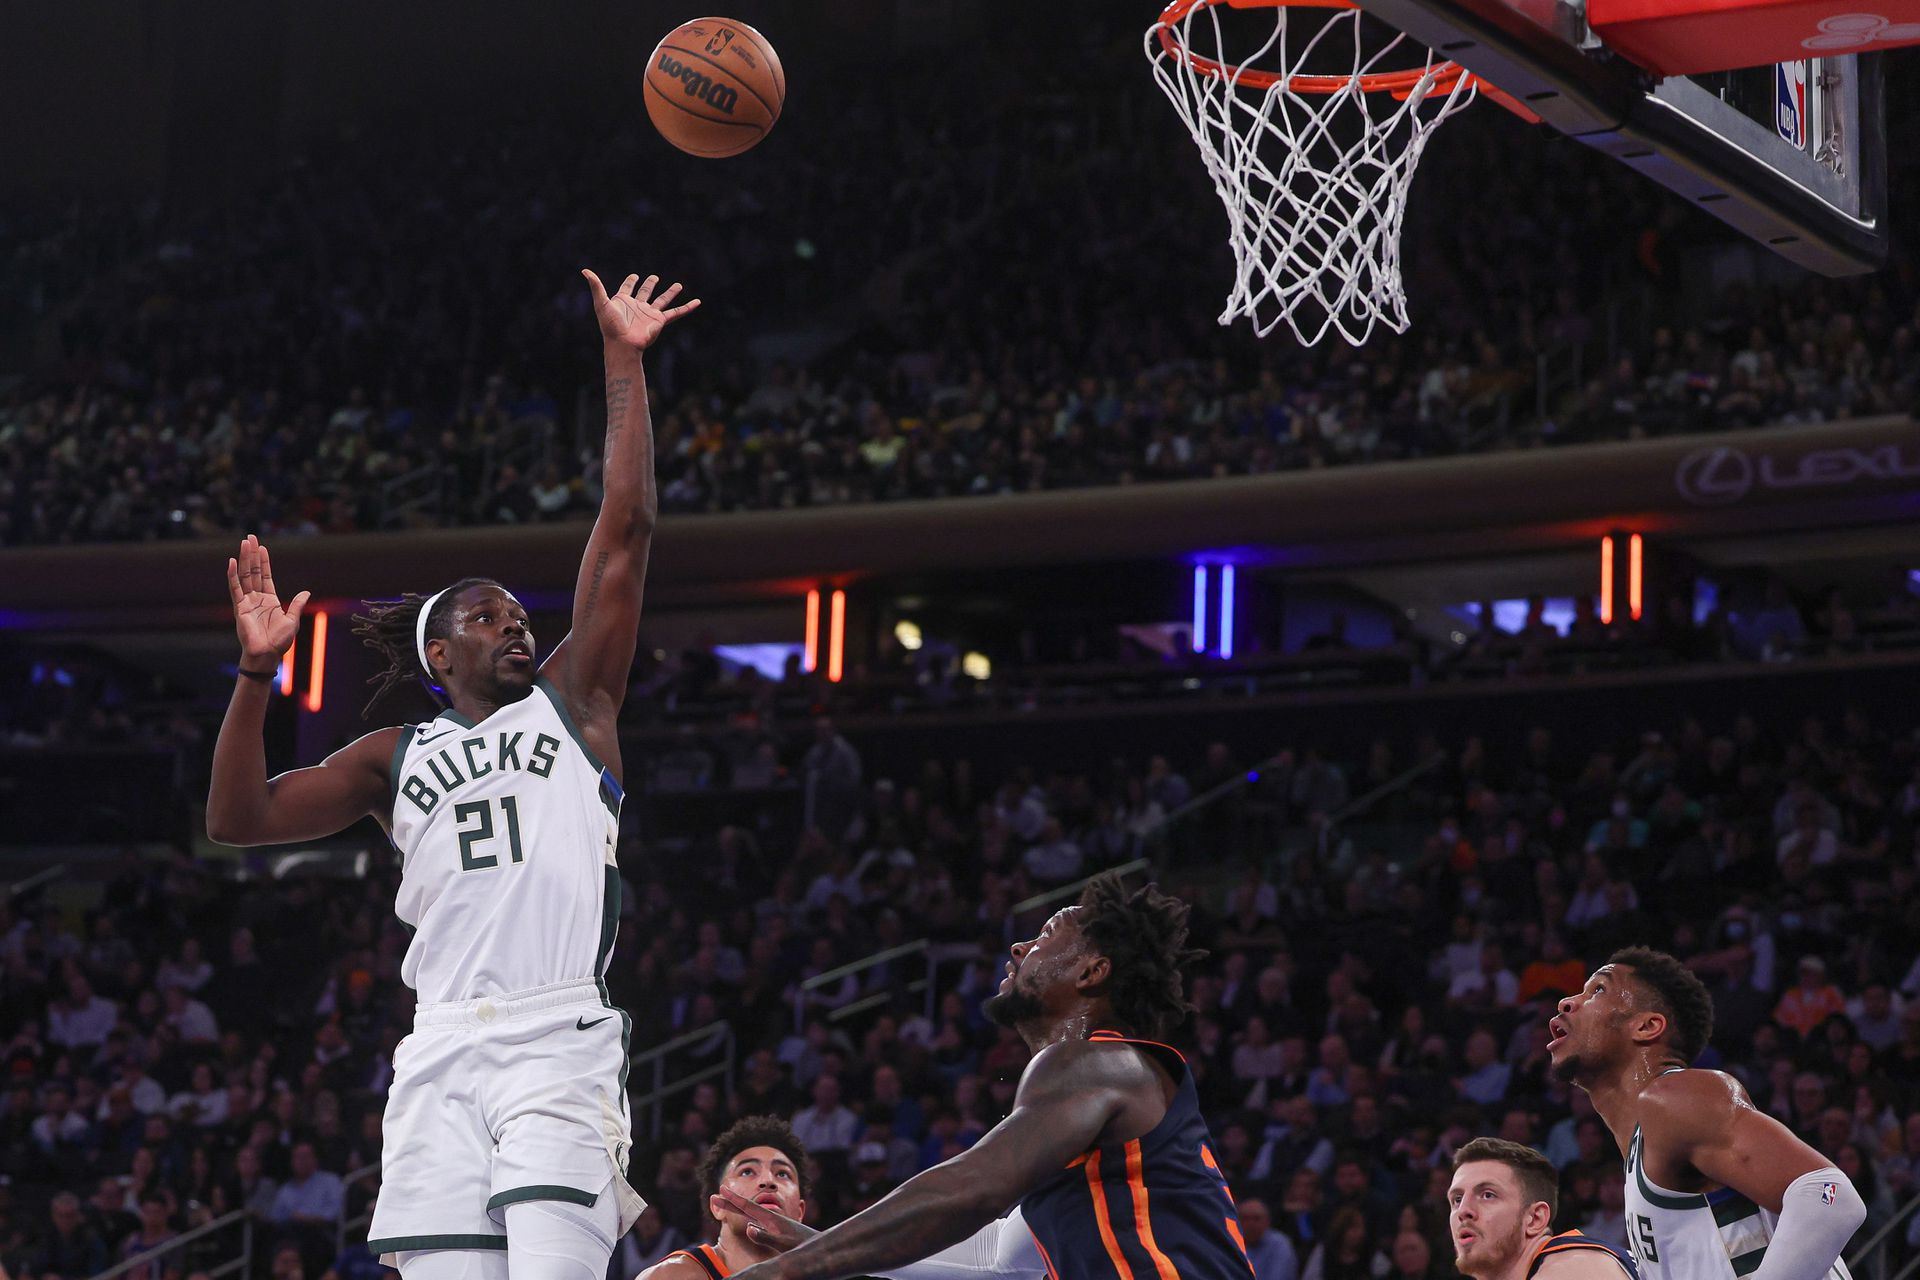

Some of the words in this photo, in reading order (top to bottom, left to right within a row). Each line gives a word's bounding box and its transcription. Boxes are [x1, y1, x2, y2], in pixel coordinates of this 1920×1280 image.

[657, 53, 738, 115] Wilson
[1780, 102, 1795, 134] NBA
[401, 731, 561, 816] BUCKS
[454, 795, 524, 872] 21
